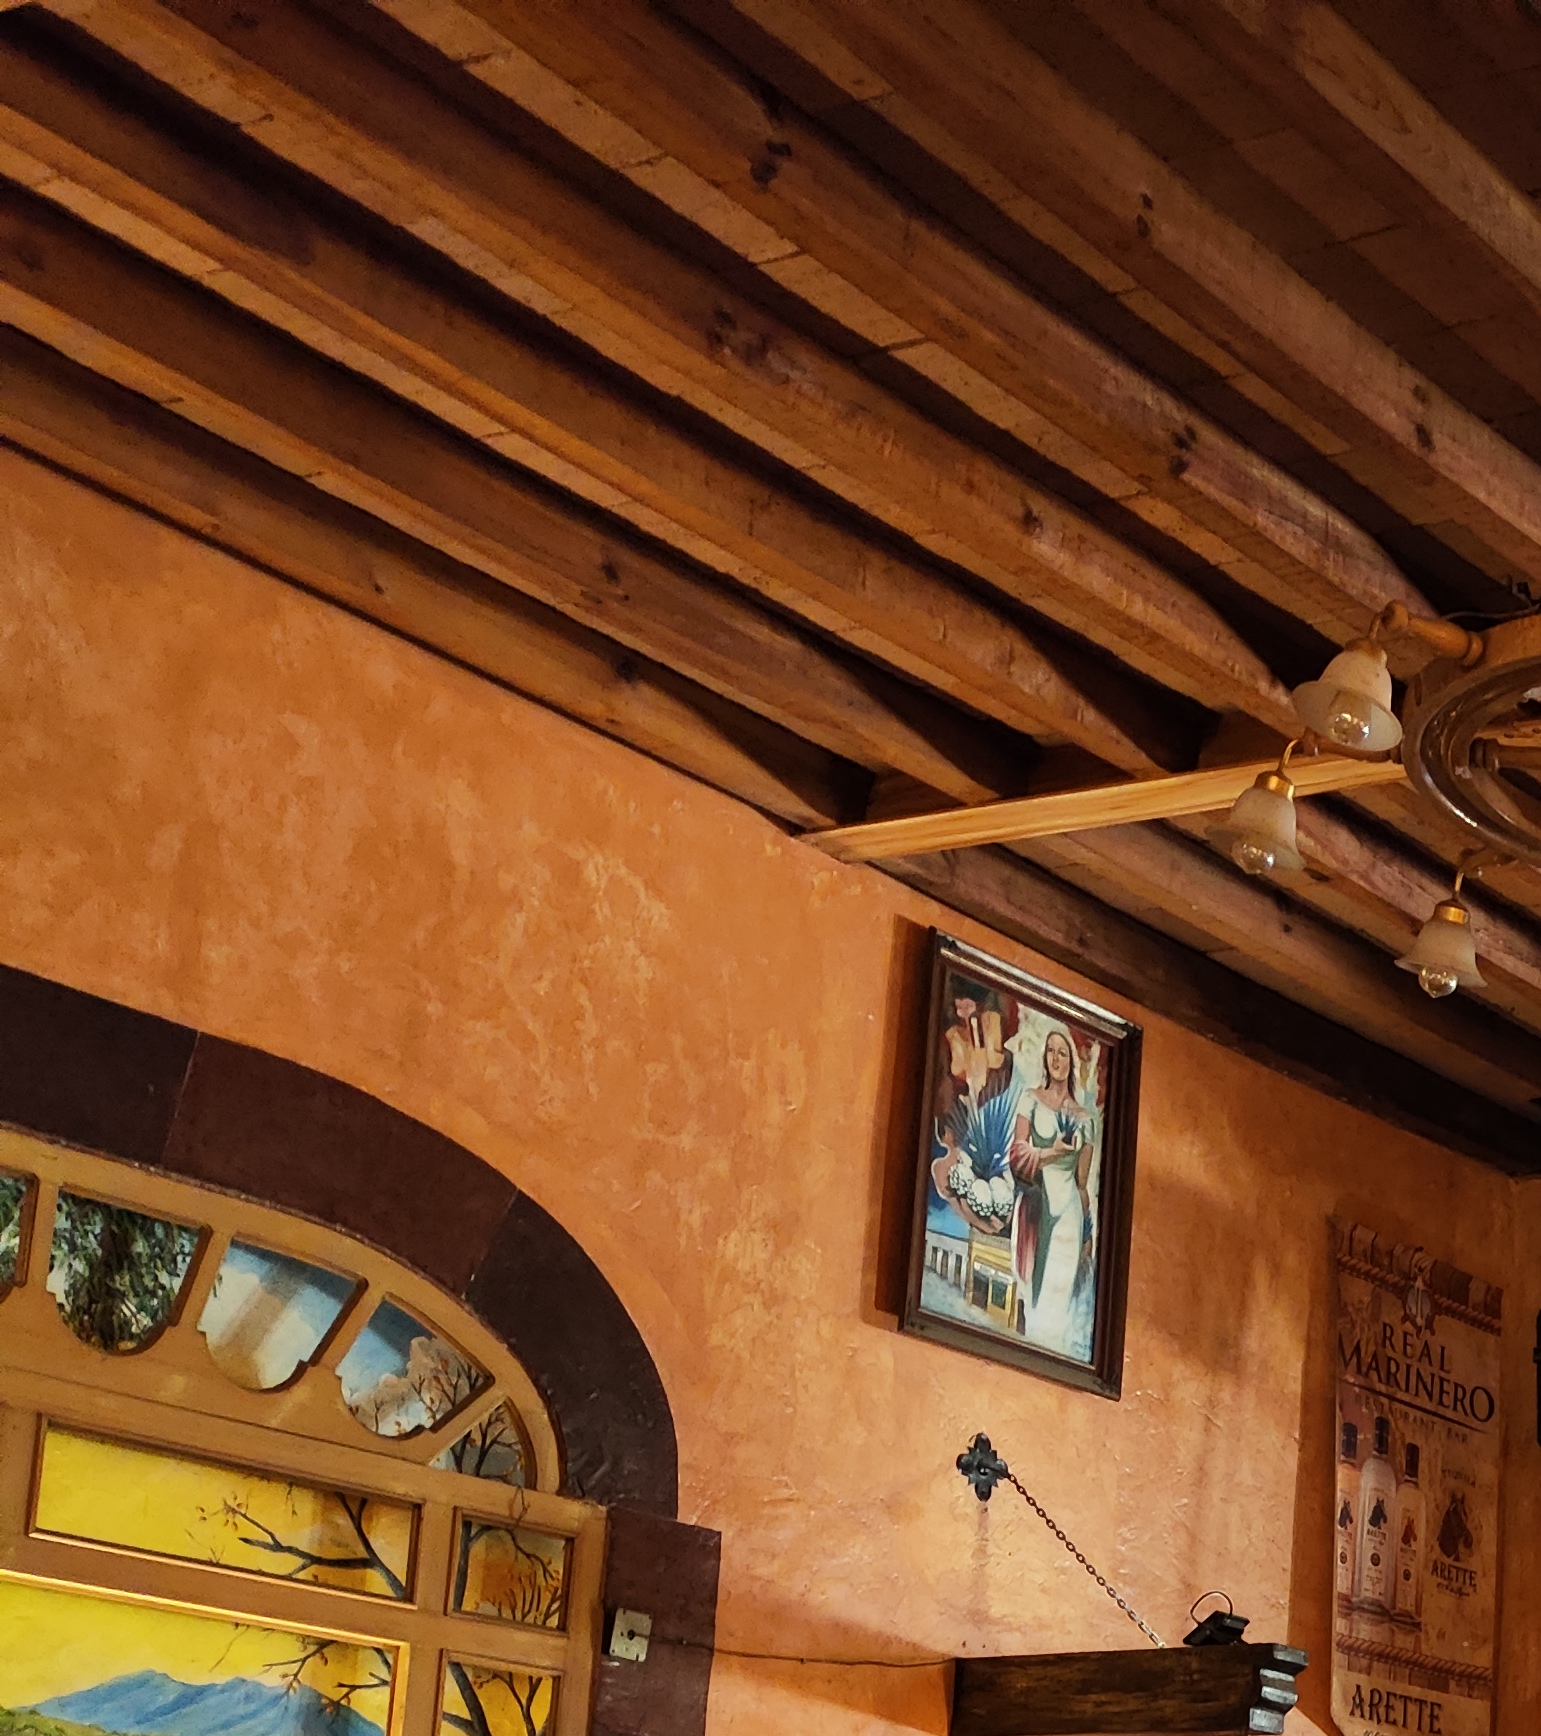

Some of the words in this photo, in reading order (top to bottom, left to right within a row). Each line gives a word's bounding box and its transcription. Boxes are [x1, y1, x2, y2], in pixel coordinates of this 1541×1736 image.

[1382, 1322, 1451, 1374] REAL
[1338, 1332, 1495, 1423] MARINERO
[1430, 1559, 1478, 1588] ARETTE
[1349, 1684, 1443, 1735] ARETTE
